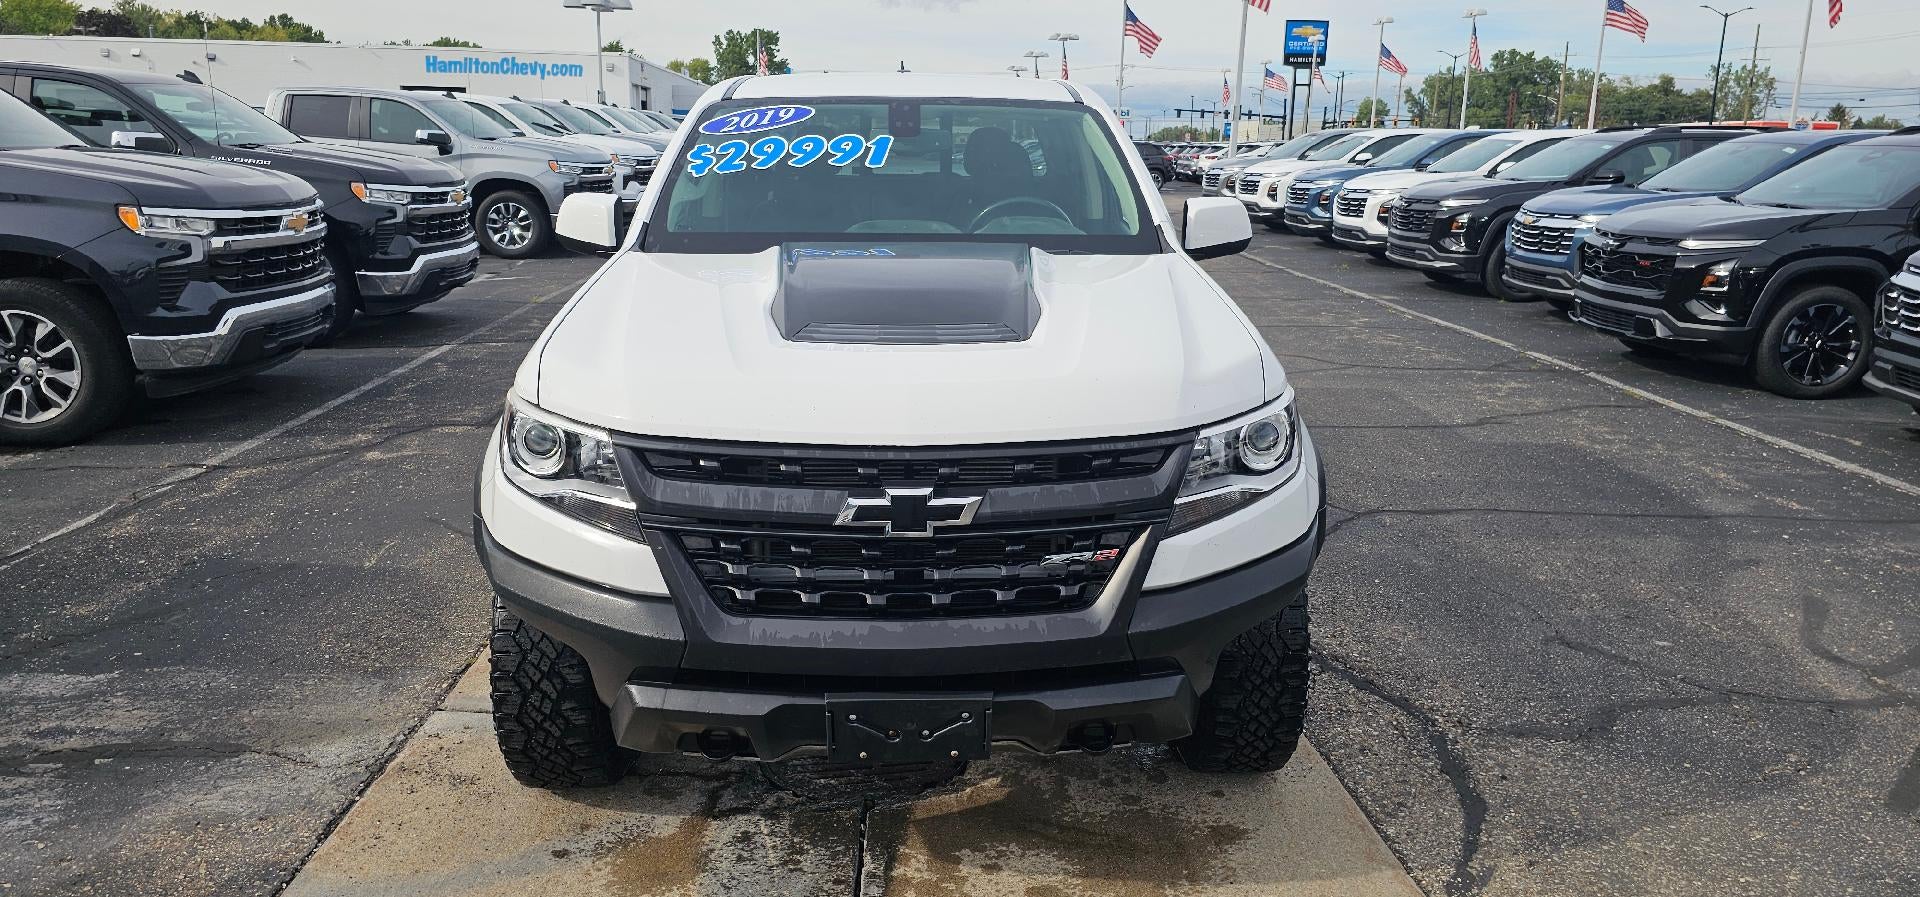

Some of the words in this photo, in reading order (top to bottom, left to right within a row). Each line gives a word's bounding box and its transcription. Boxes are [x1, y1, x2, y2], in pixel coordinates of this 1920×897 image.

[425, 55, 583, 80] HamiltonChevy.com
[719, 107, 795, 133] 2019
[687, 134, 894, 177] $29991
[1040, 548, 1120, 567] ZR2
